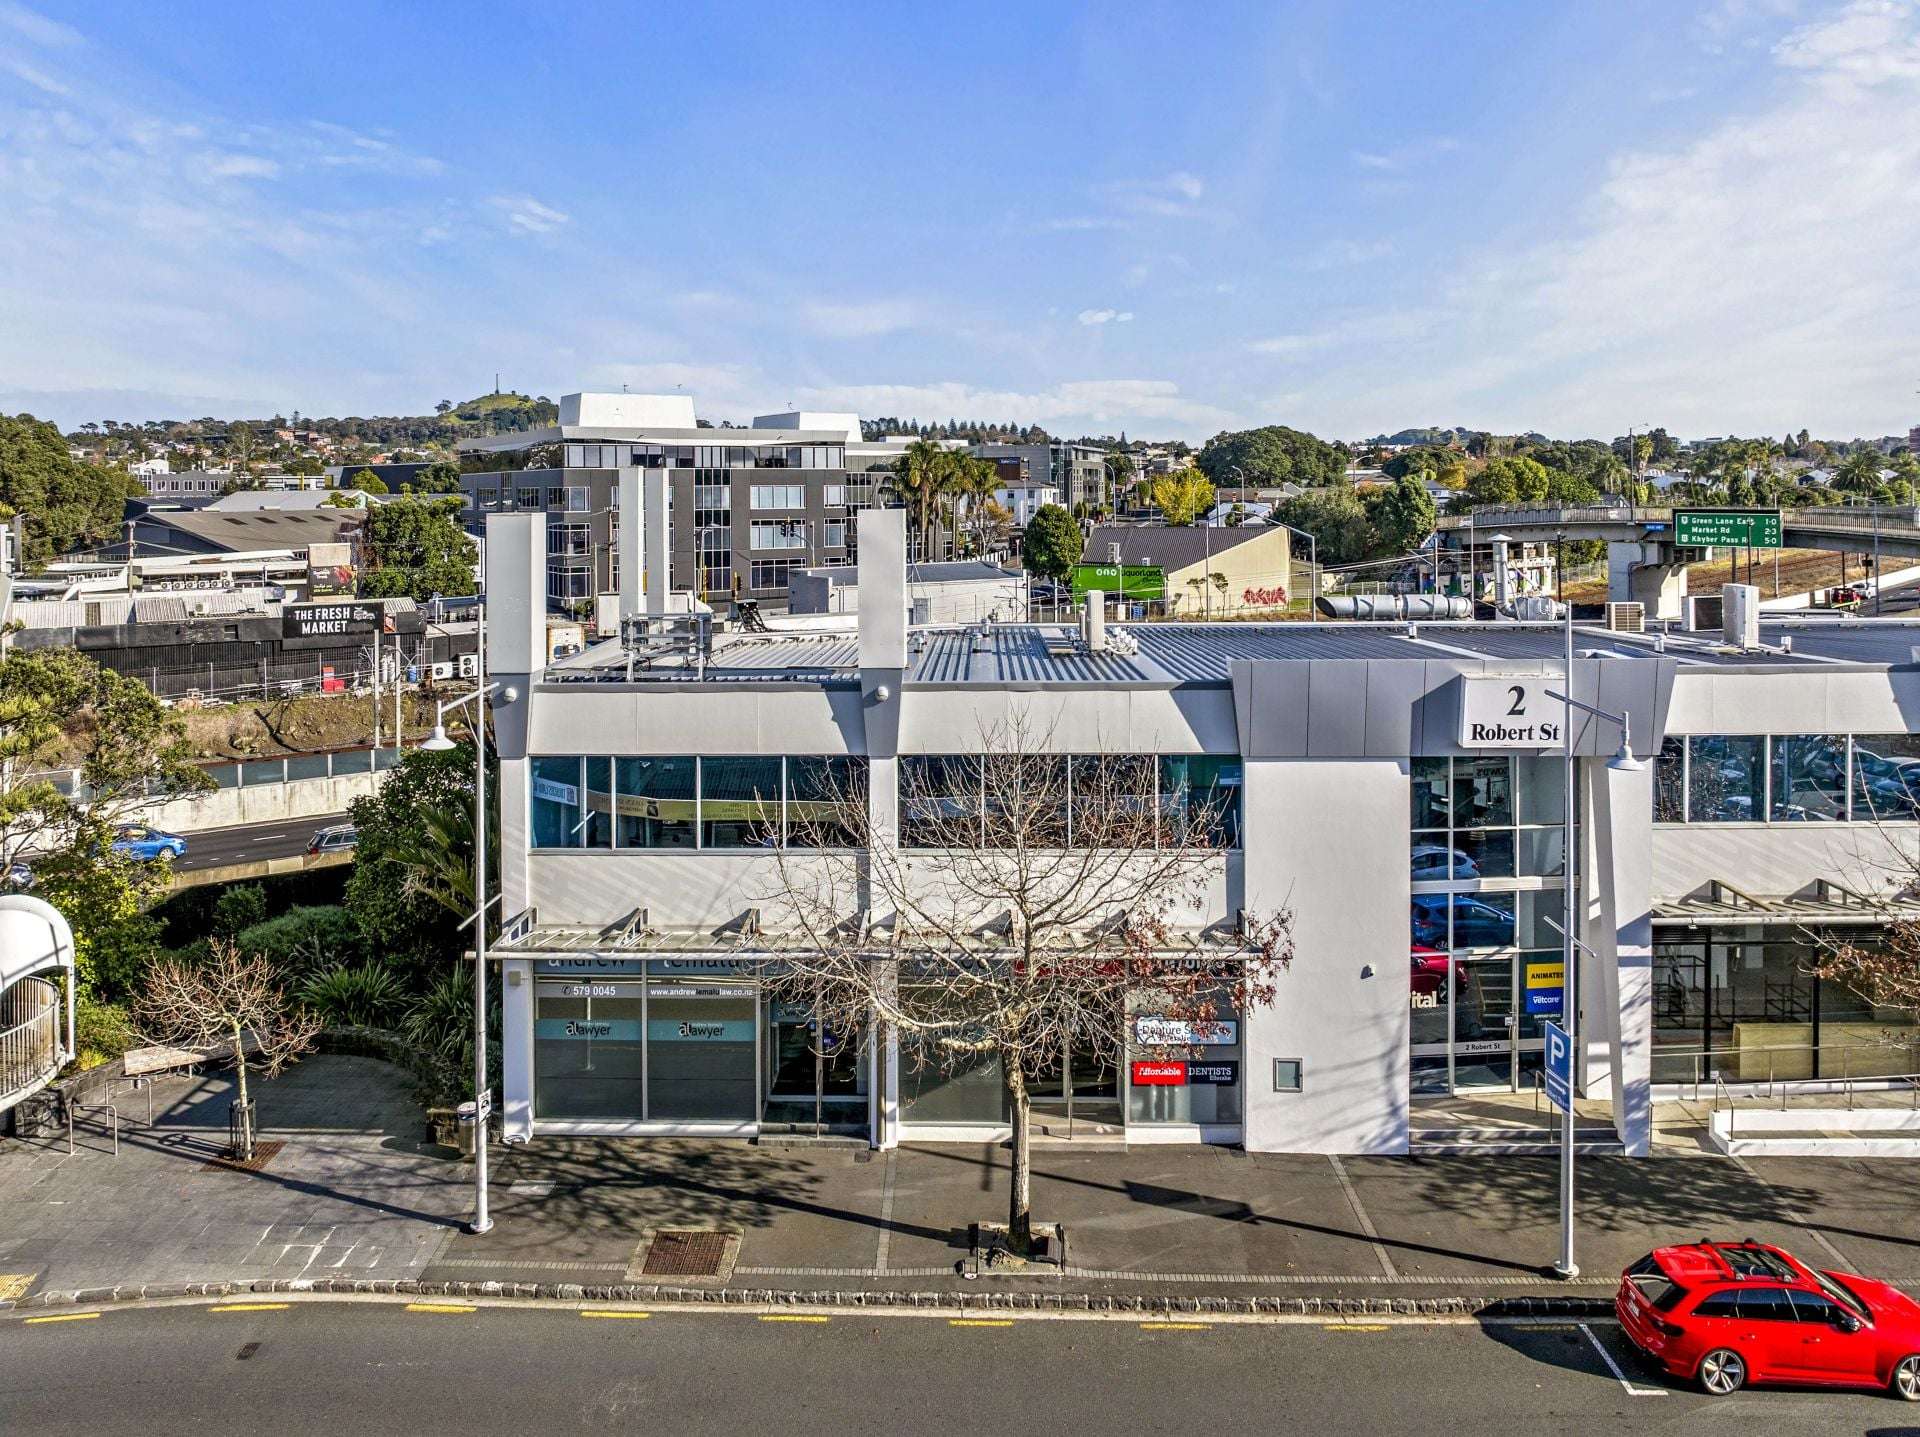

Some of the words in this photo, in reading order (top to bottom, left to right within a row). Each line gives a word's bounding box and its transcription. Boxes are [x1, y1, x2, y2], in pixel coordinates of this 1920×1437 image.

[1715, 517, 1734, 525] Lane
[1736, 518, 1753, 526] Ea
[1692, 536, 1718, 545] Khyber
[294, 610, 313, 621] THE
[315, 607, 350, 620] FRESH
[301, 621, 347, 634] MARKET
[1507, 685, 1526, 716] 2
[1470, 723, 1535, 741] Robert
[1539, 723, 1560, 741] St
[573, 985, 590, 996] 579
[593, 985, 616, 996] 0045
[1408, 990, 1437, 1009] ital
[1493, 1042, 1501, 1050] St
[1551, 1033, 1565, 1066] P
[1188, 1067, 1232, 1076] DENTISTS
